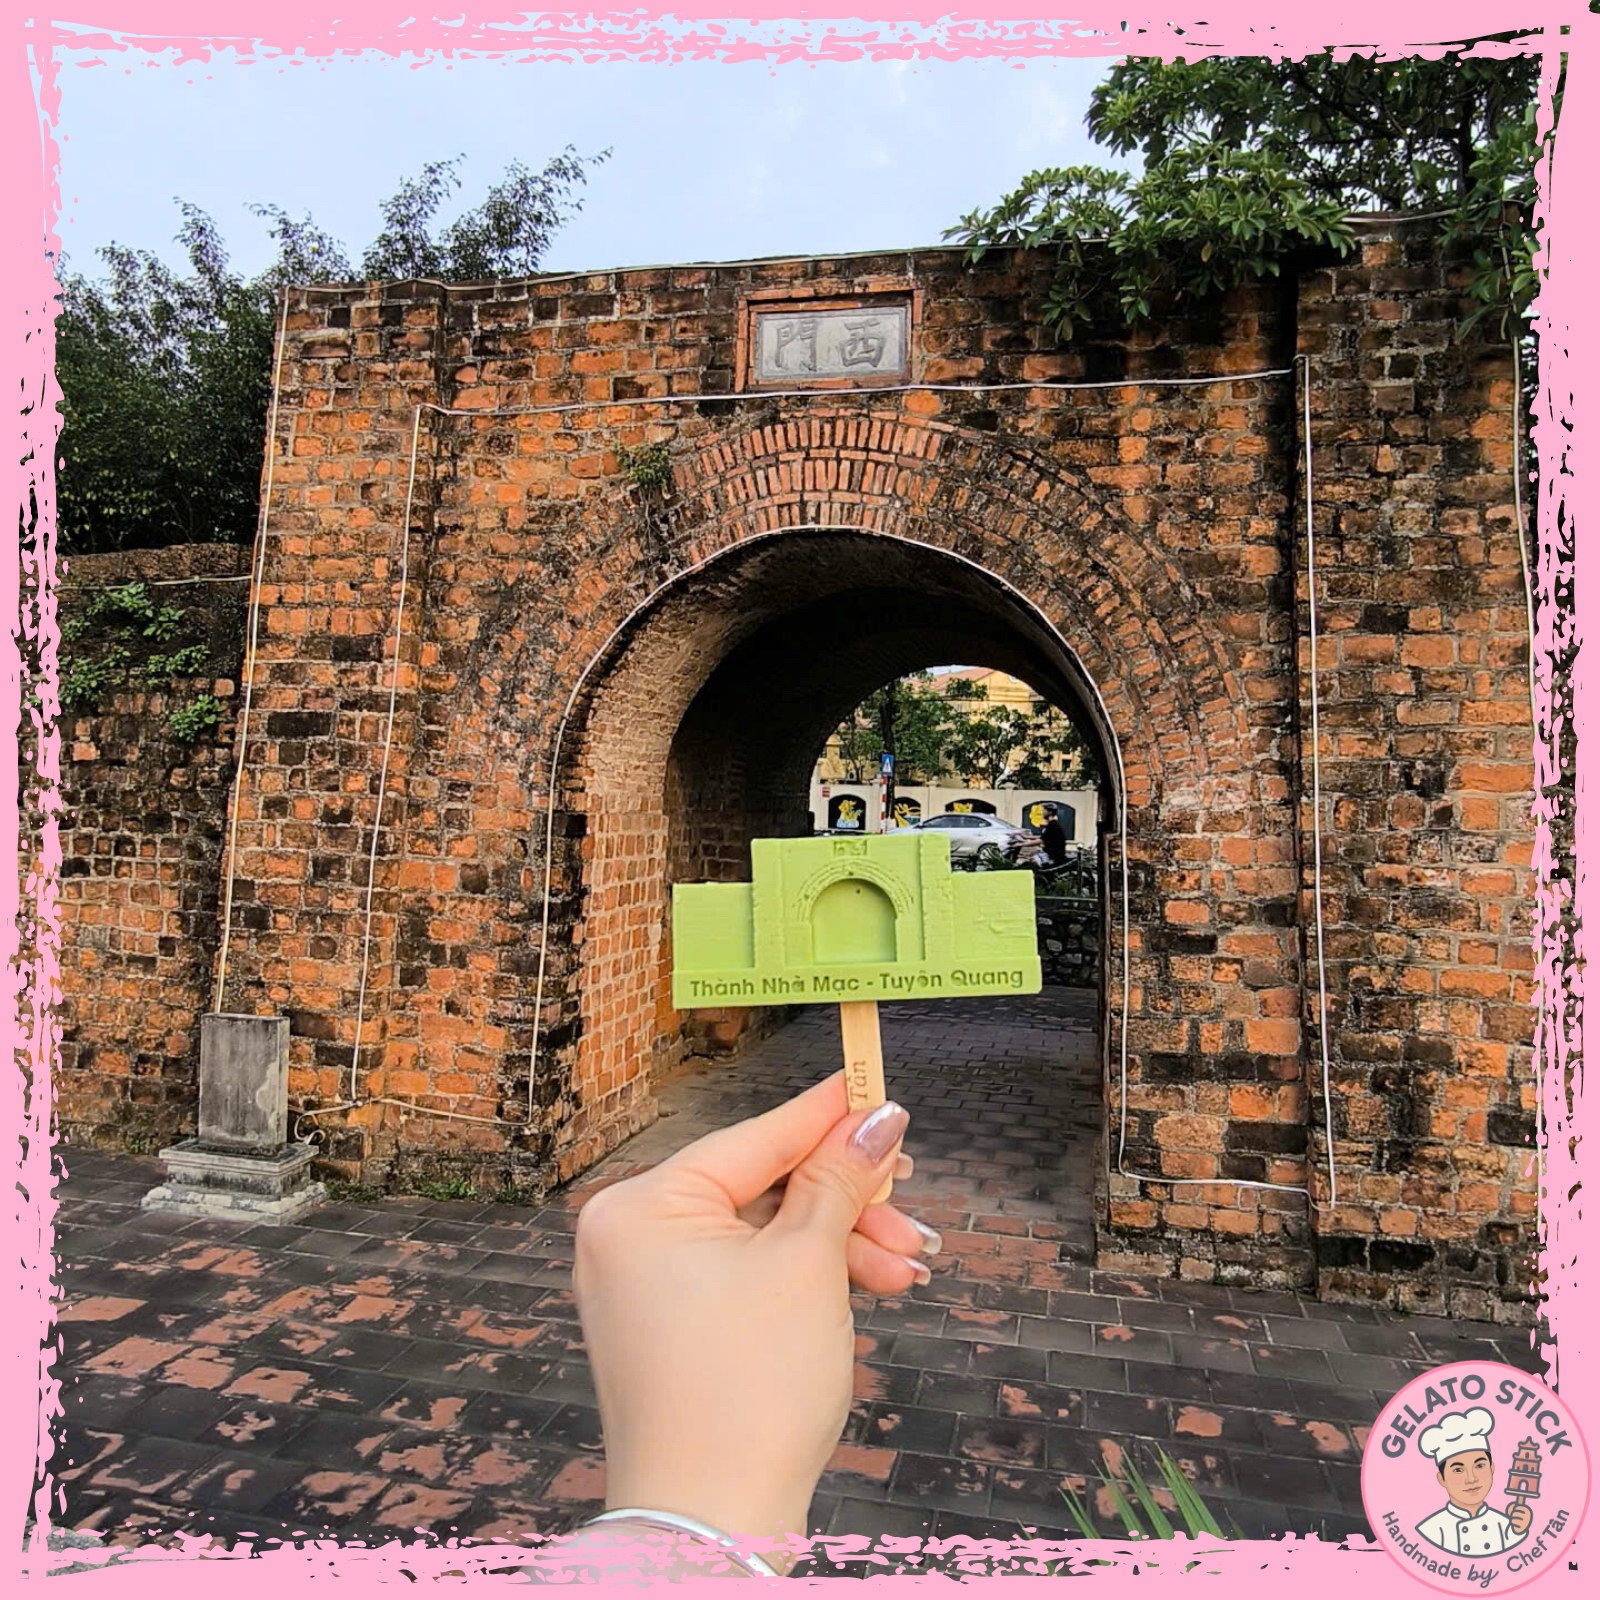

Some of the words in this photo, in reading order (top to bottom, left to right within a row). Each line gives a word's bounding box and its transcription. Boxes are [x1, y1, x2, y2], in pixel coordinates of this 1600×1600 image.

[690, 978, 754, 997] Thành
[763, 975, 805, 995] Nhà
[812, 975, 859, 996] Mạc
[951, 969, 1023, 989] Quang
